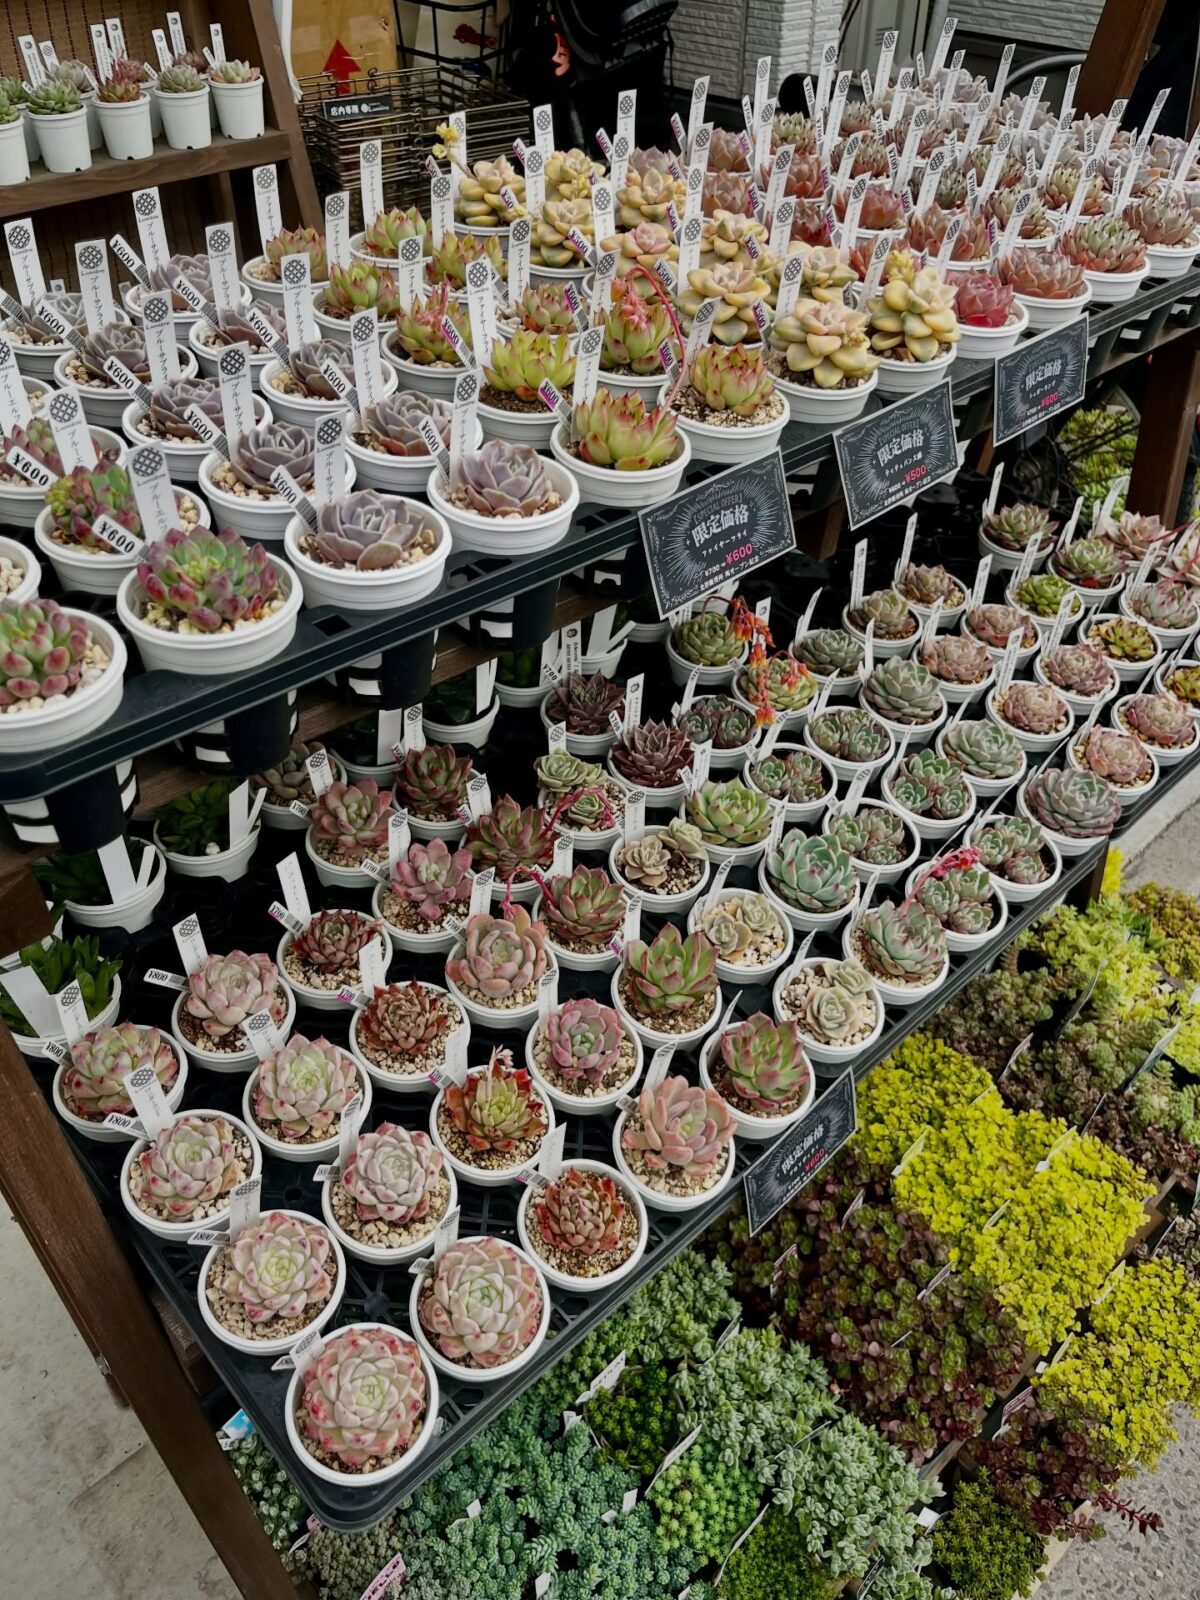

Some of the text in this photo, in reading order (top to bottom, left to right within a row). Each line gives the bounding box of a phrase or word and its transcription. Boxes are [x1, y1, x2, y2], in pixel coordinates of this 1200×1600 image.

[110, 240, 135, 268] ¥600
[569, 230, 589, 255] ¥500
[656, 262, 673, 287] ¥500
[176, 280, 201, 306] ¥600
[38, 306, 66, 335] ¥600
[249, 312, 274, 343] ¥600
[444, 318, 460, 346] ¥600
[107, 361, 135, 390] ¥600
[323, 364, 346, 394] ¥600
[1025, 359, 1062, 391] 限定価格
[543, 381, 560, 406] ¥600
[186, 410, 214, 441] ¥600
[421, 421, 440, 453] ¥600
[876, 429, 924, 467] 限定価格
[13, 453, 49, 486] ¥600
[904, 465, 927, 482] ¥500
[272, 472, 297, 505] ¥600
[99, 521, 136, 554] ¥600
[691, 503, 749, 547] 限定価格
[701, 529, 748, 558] ファイヤーフライ
[725, 543, 753, 565] ¥600
[542, 664, 558, 681] ¥700
[609, 713, 621, 732] ¥700
[363, 860, 379, 874] ¥700
[148, 970, 168, 982] ¥800
[45, 1042, 65, 1058] ¥800
[107, 1114, 131, 1128] ¥800
[193, 1232, 214, 1242] ¥800
